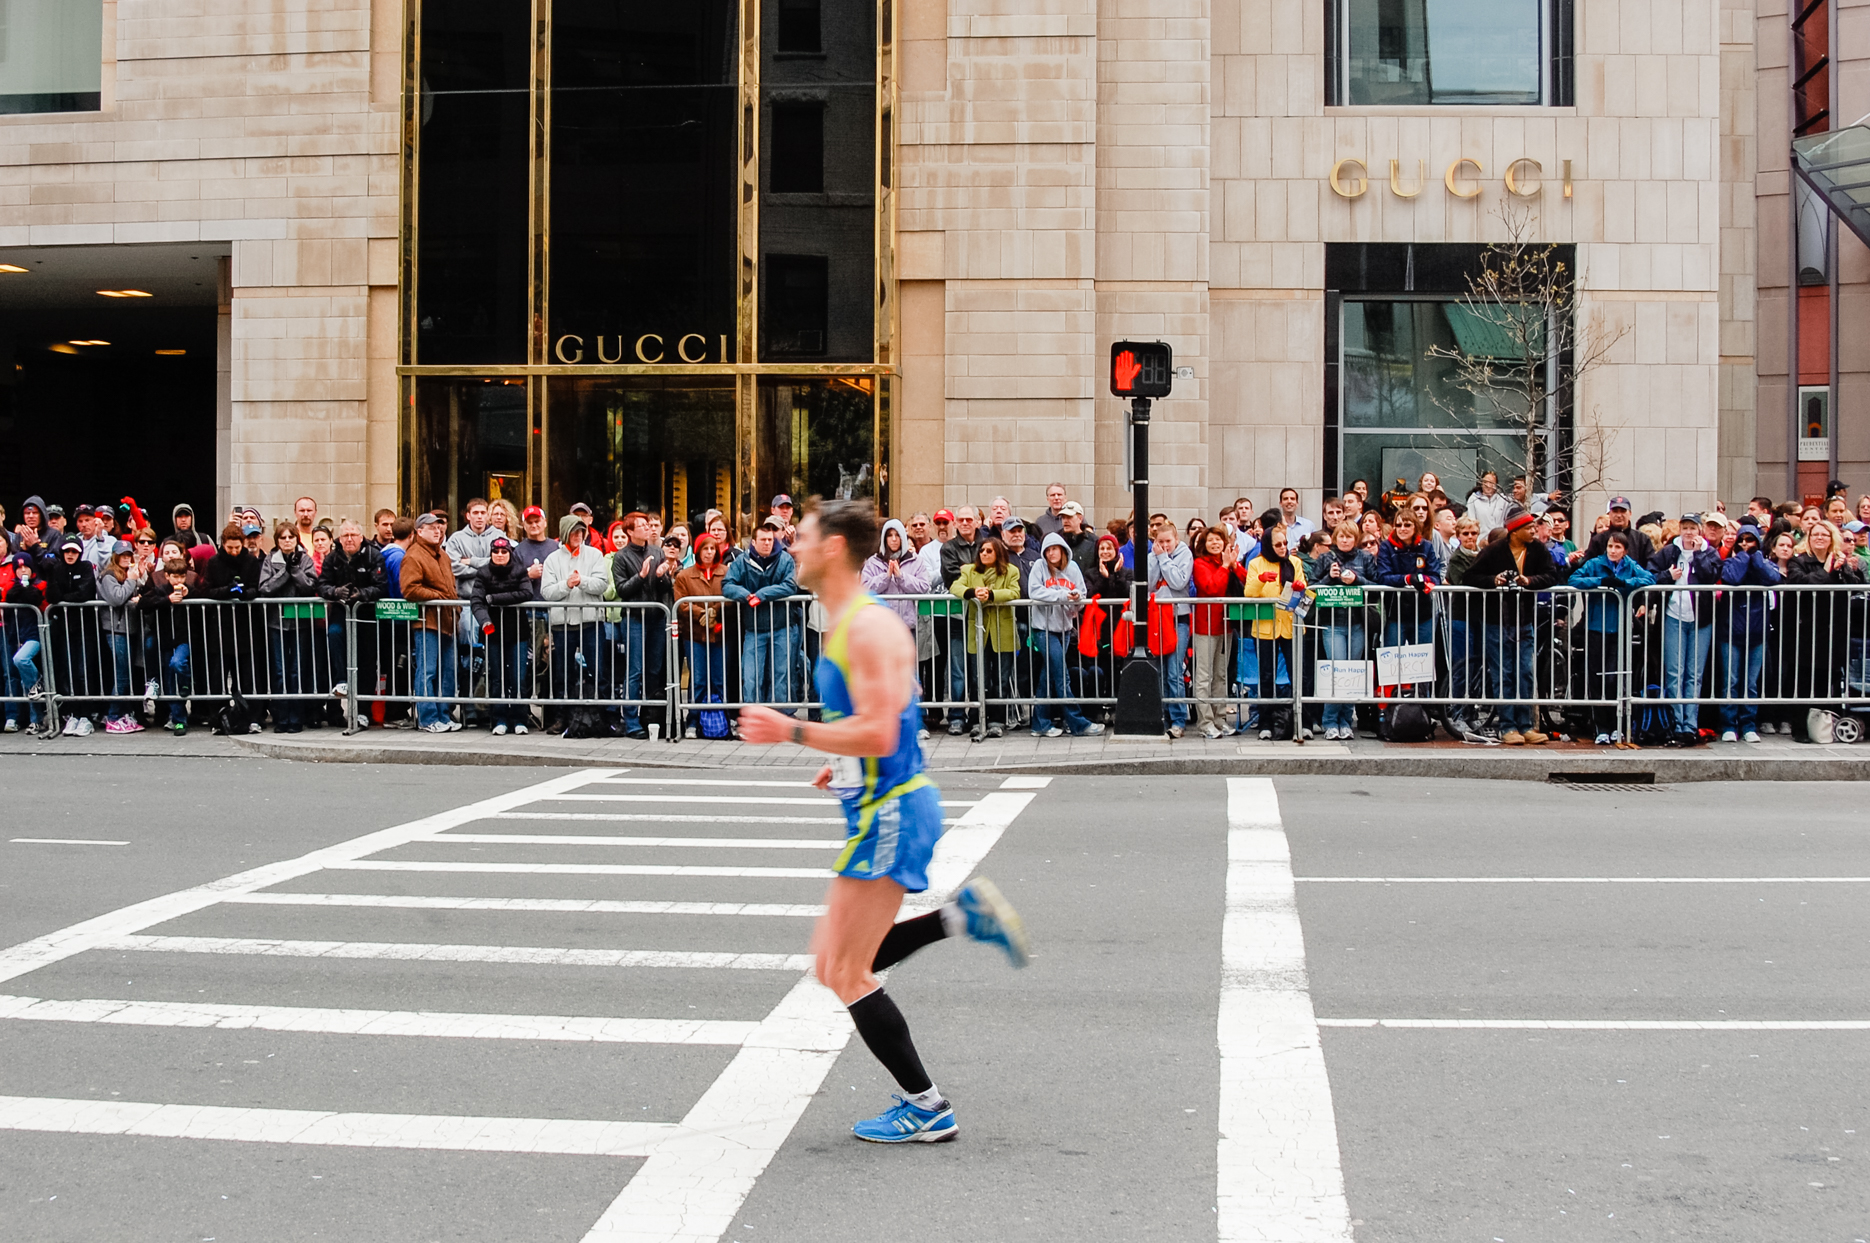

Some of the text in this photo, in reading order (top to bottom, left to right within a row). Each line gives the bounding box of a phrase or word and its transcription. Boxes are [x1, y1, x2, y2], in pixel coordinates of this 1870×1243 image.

[1329, 157, 1573, 198] GUCCI
[555, 333, 728, 364] GUCCI
[1317, 588, 1361, 596] WOOD & WIRE
[402, 602, 416, 610] WIRE
[1390, 658, 1426, 677] DARCY
[1330, 673, 1364, 688] SCOTT
